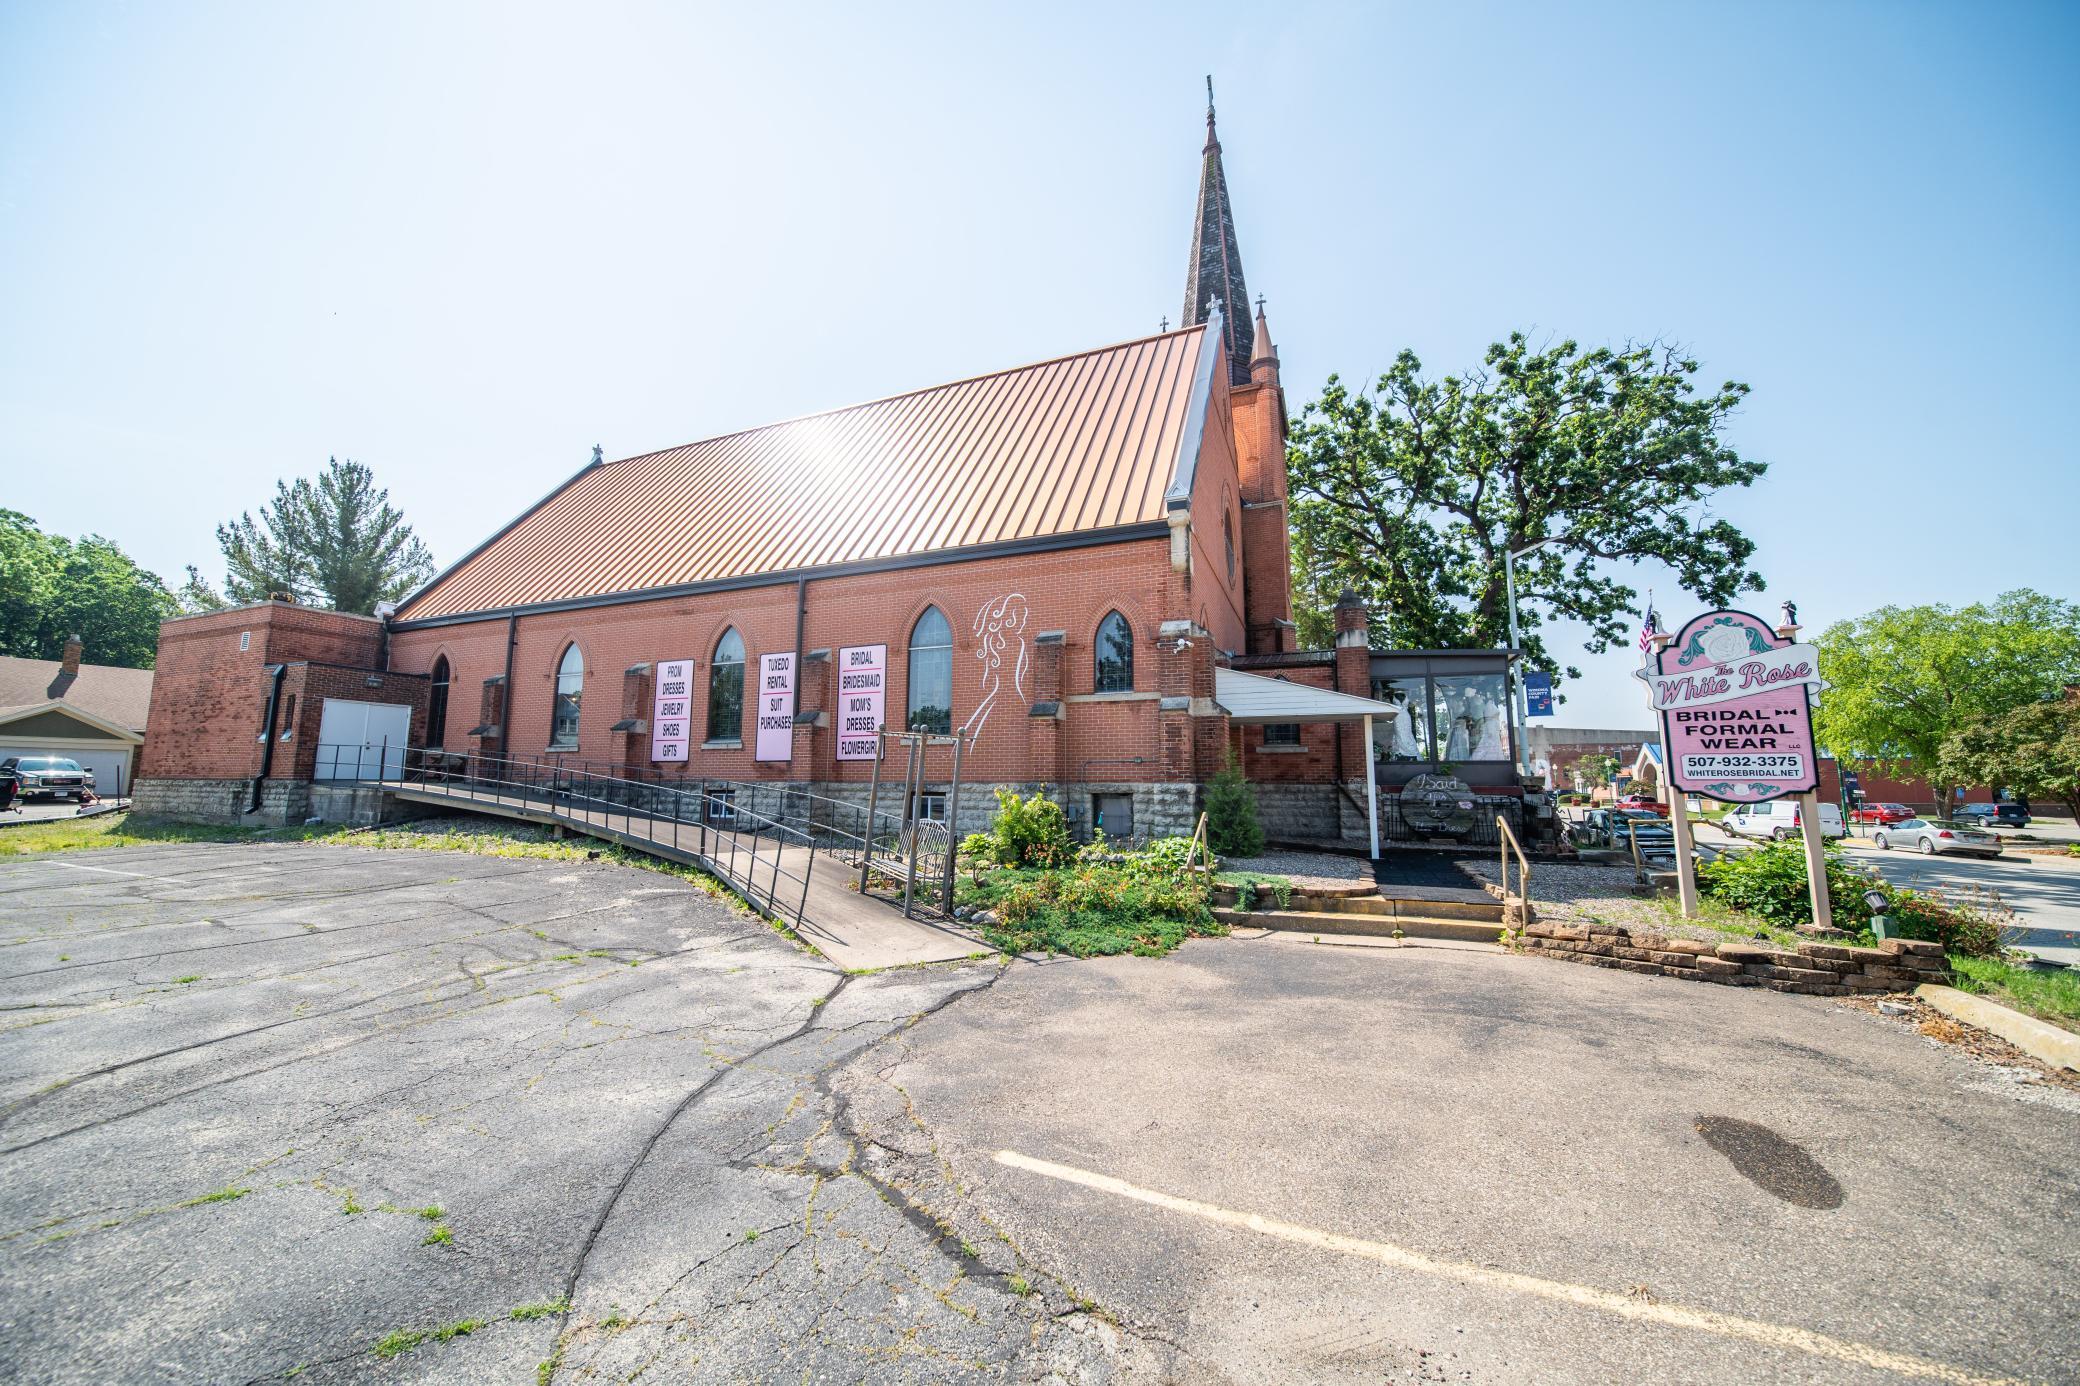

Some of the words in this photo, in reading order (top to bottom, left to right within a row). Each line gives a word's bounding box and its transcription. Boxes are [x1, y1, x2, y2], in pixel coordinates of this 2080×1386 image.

[768, 658, 790, 672] TUXEDO
[850, 651, 873, 666] BRIDAL
[667, 665, 682, 678] PROM
[1714, 664, 1734, 676] The
[767, 676, 788, 689] RENTAL
[842, 674, 880, 690] BRIDESMAID
[1658, 677, 1730, 705] White
[1738, 662, 1812, 689] Rose
[662, 682, 685, 696] DRESSES
[661, 702, 684, 716] JEWELRY
[770, 698, 782, 712] SUIT
[850, 698, 872, 712] MOM'S
[1676, 710, 1770, 722] BRIDAL
[760, 716, 792, 730] PURCHASES
[846, 716, 875, 732] DRESSES
[662, 724, 680, 736] SHOES
[1685, 724, 1794, 736] FORMAL
[662, 744, 678, 757] GIFTS
[1700, 738, 1777, 750] WEAR
[1688, 756, 1798, 767] 507-932-3375
[1687, 769, 1800, 777] WHITEROSEBRIDAL.NET
